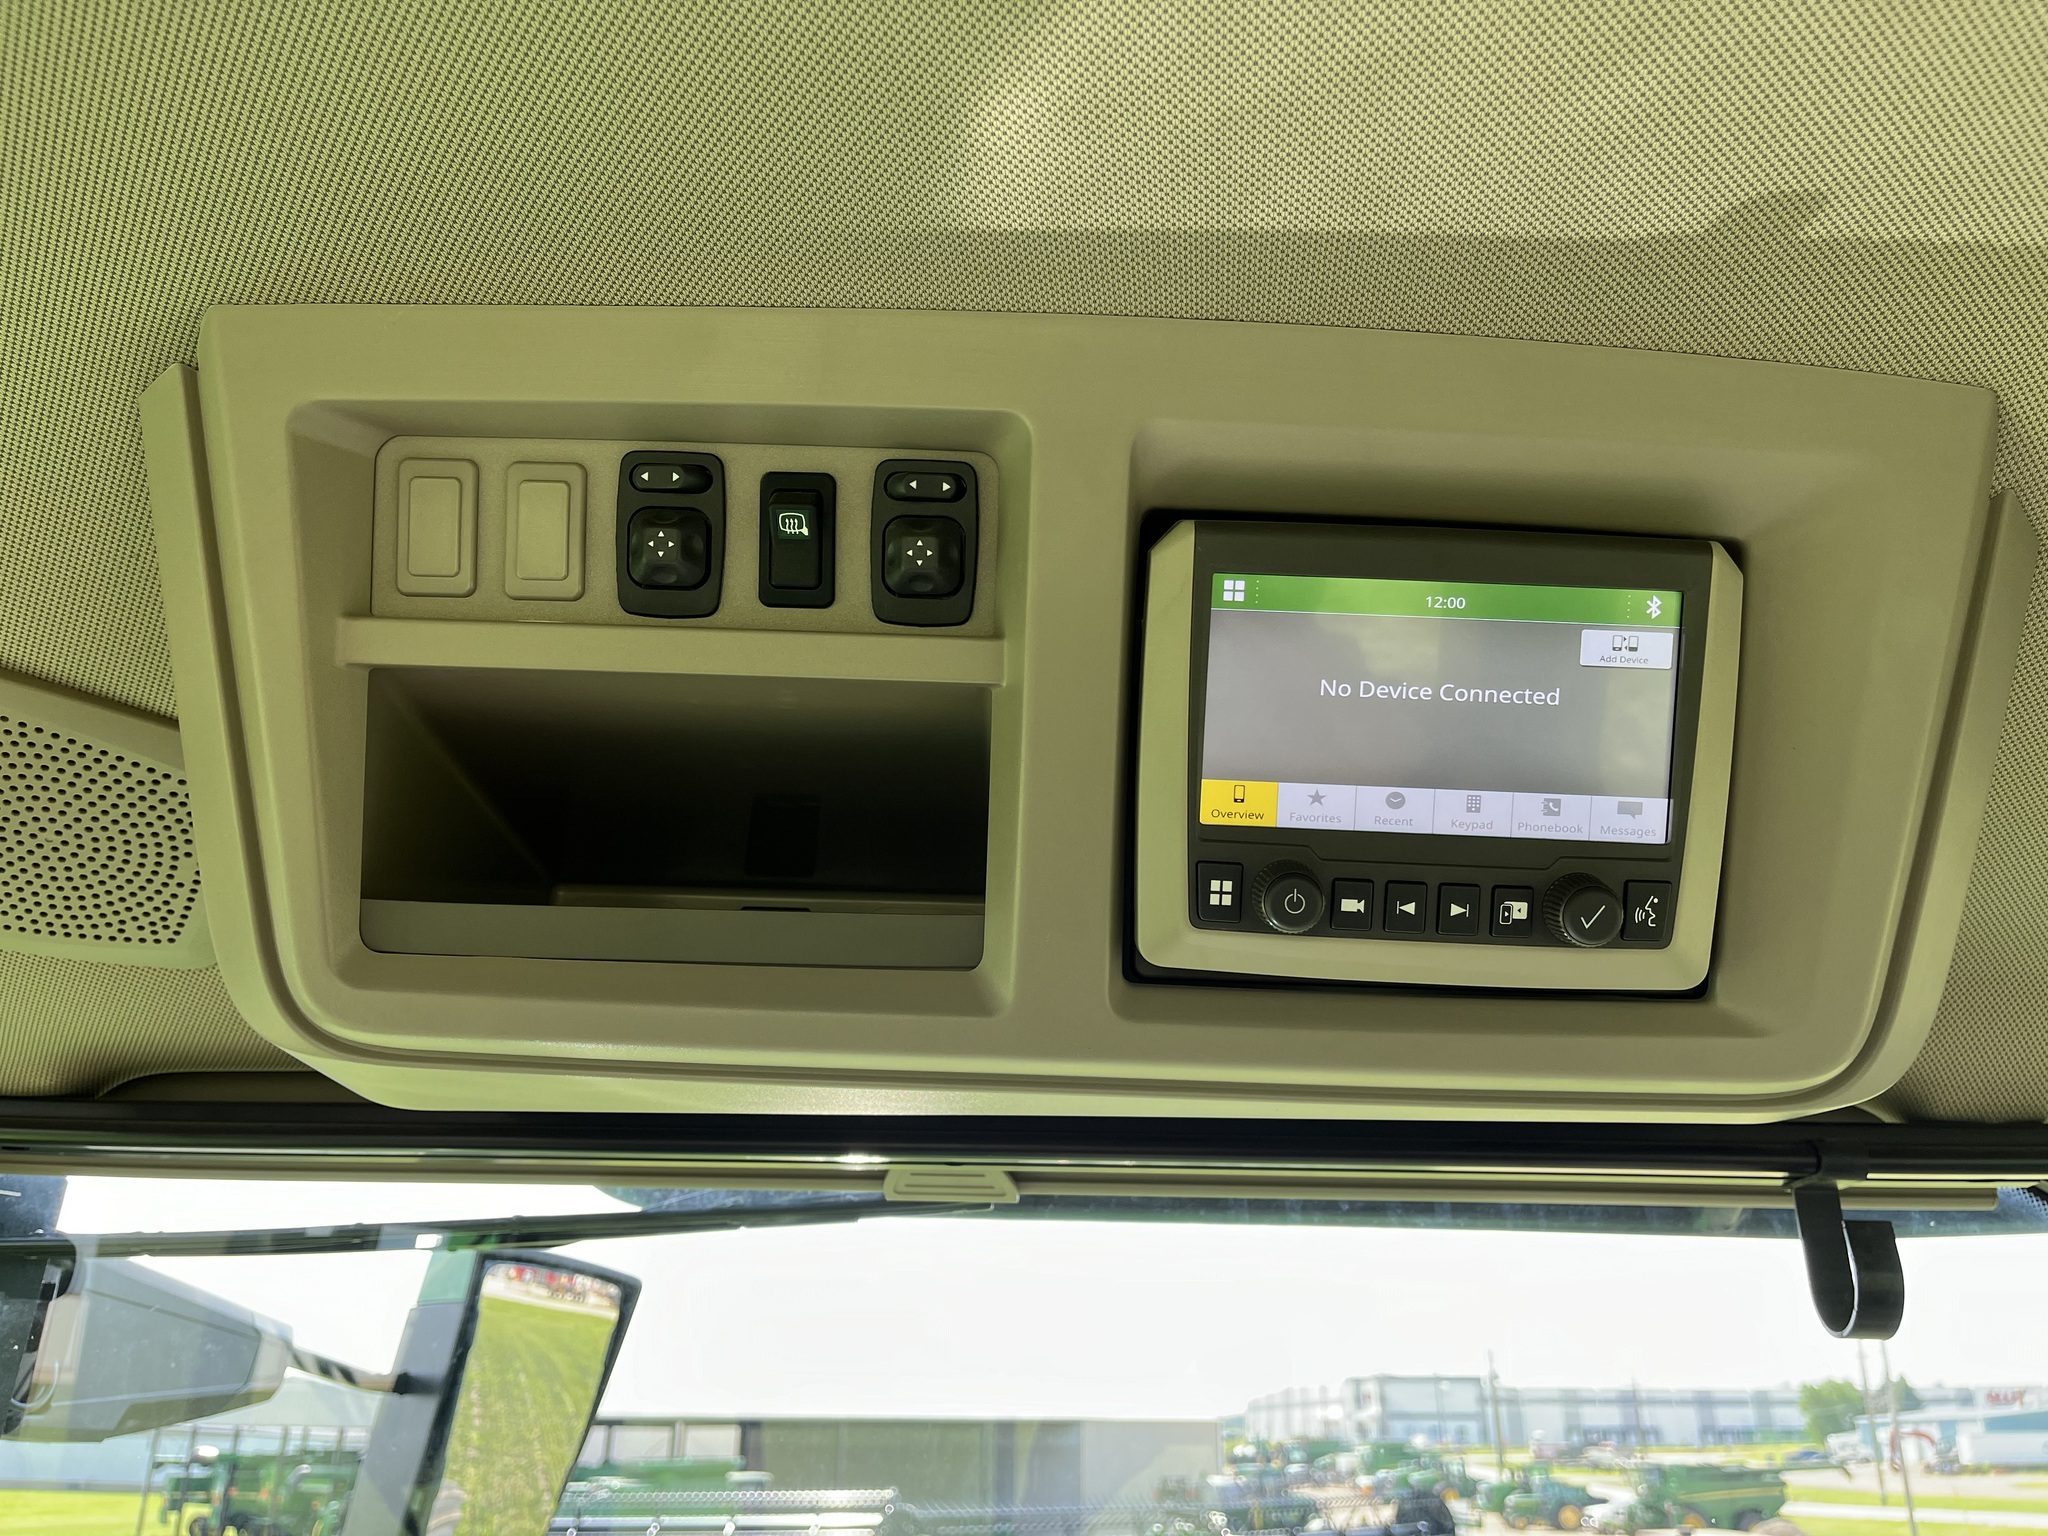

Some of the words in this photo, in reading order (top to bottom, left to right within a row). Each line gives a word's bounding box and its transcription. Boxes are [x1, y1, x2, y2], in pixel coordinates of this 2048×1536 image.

[1425, 596, 1466, 610] 12:00
[1599, 655, 1617, 664] Add
[1619, 655, 1649, 665] Device
[1320, 679, 1352, 697] No
[1359, 680, 1433, 701] Device
[1439, 684, 1560, 706] Connected
[1211, 808, 1265, 821] Overview
[1289, 812, 1342, 824] Favorites
[1374, 815, 1413, 827] Recent
[1451, 819, 1493, 832] Keypad
[1517, 822, 1583, 834] Phonebook
[1600, 825, 1657, 838] Messages
